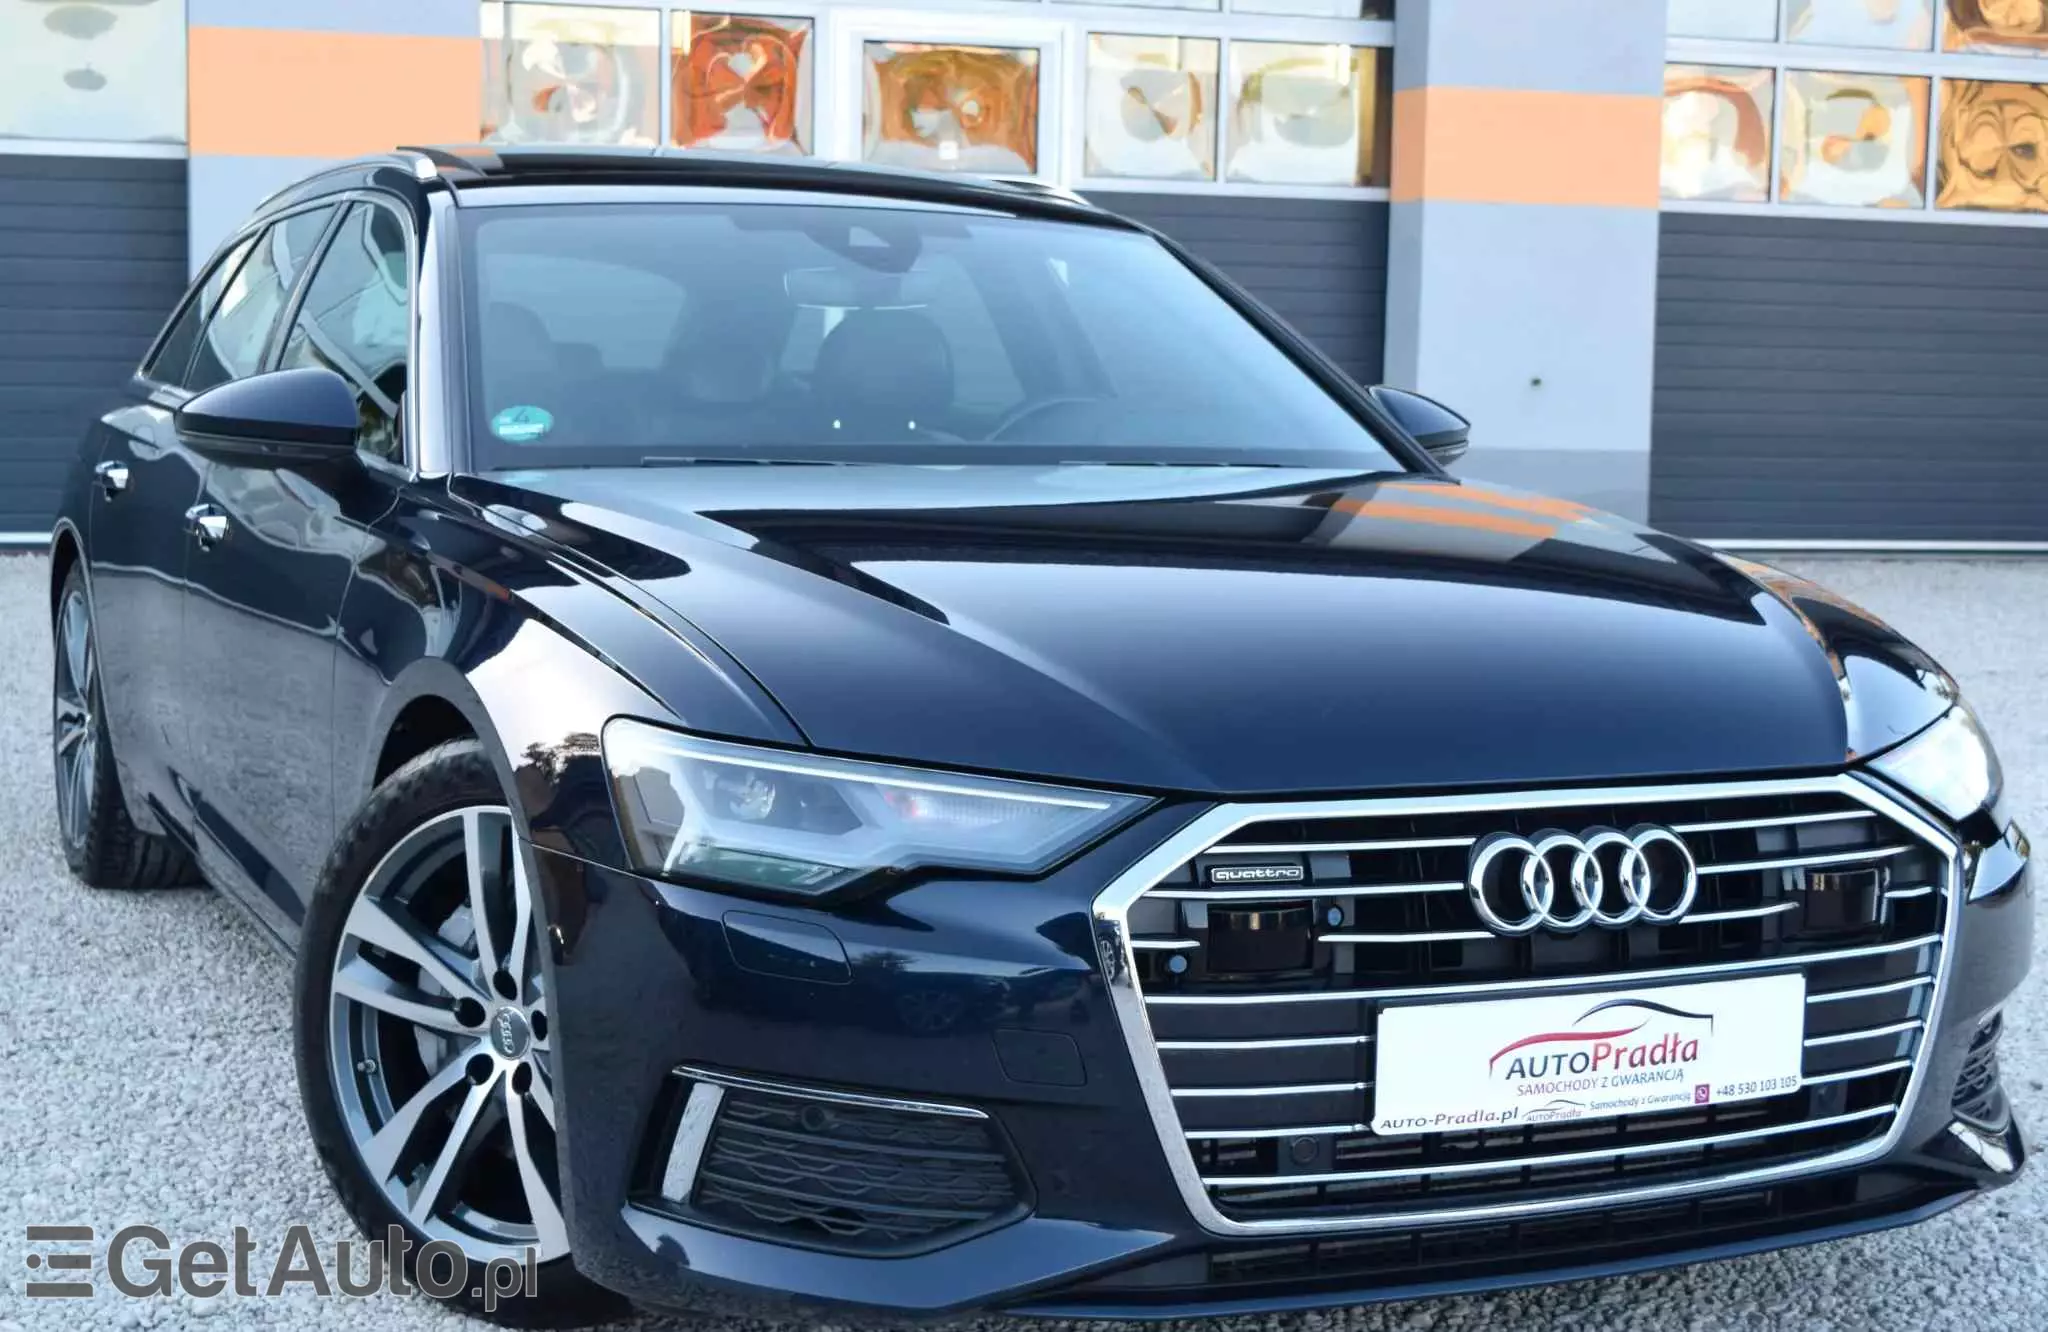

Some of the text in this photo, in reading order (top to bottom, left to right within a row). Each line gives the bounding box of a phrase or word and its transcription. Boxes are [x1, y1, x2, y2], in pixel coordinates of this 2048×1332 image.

[1215, 869, 1300, 881] quattro
[1505, 1032, 1699, 1080] AUTOPradła
[1517, 1068, 1685, 1096] SAMOCHODY Z GWARANCJĄ
[1716, 1076, 1798, 1096] +48 530 103 105
[1589, 1096, 1639, 1111] Samochody
[1380, 1106, 1519, 1129] AUTO-Pradla.pl
